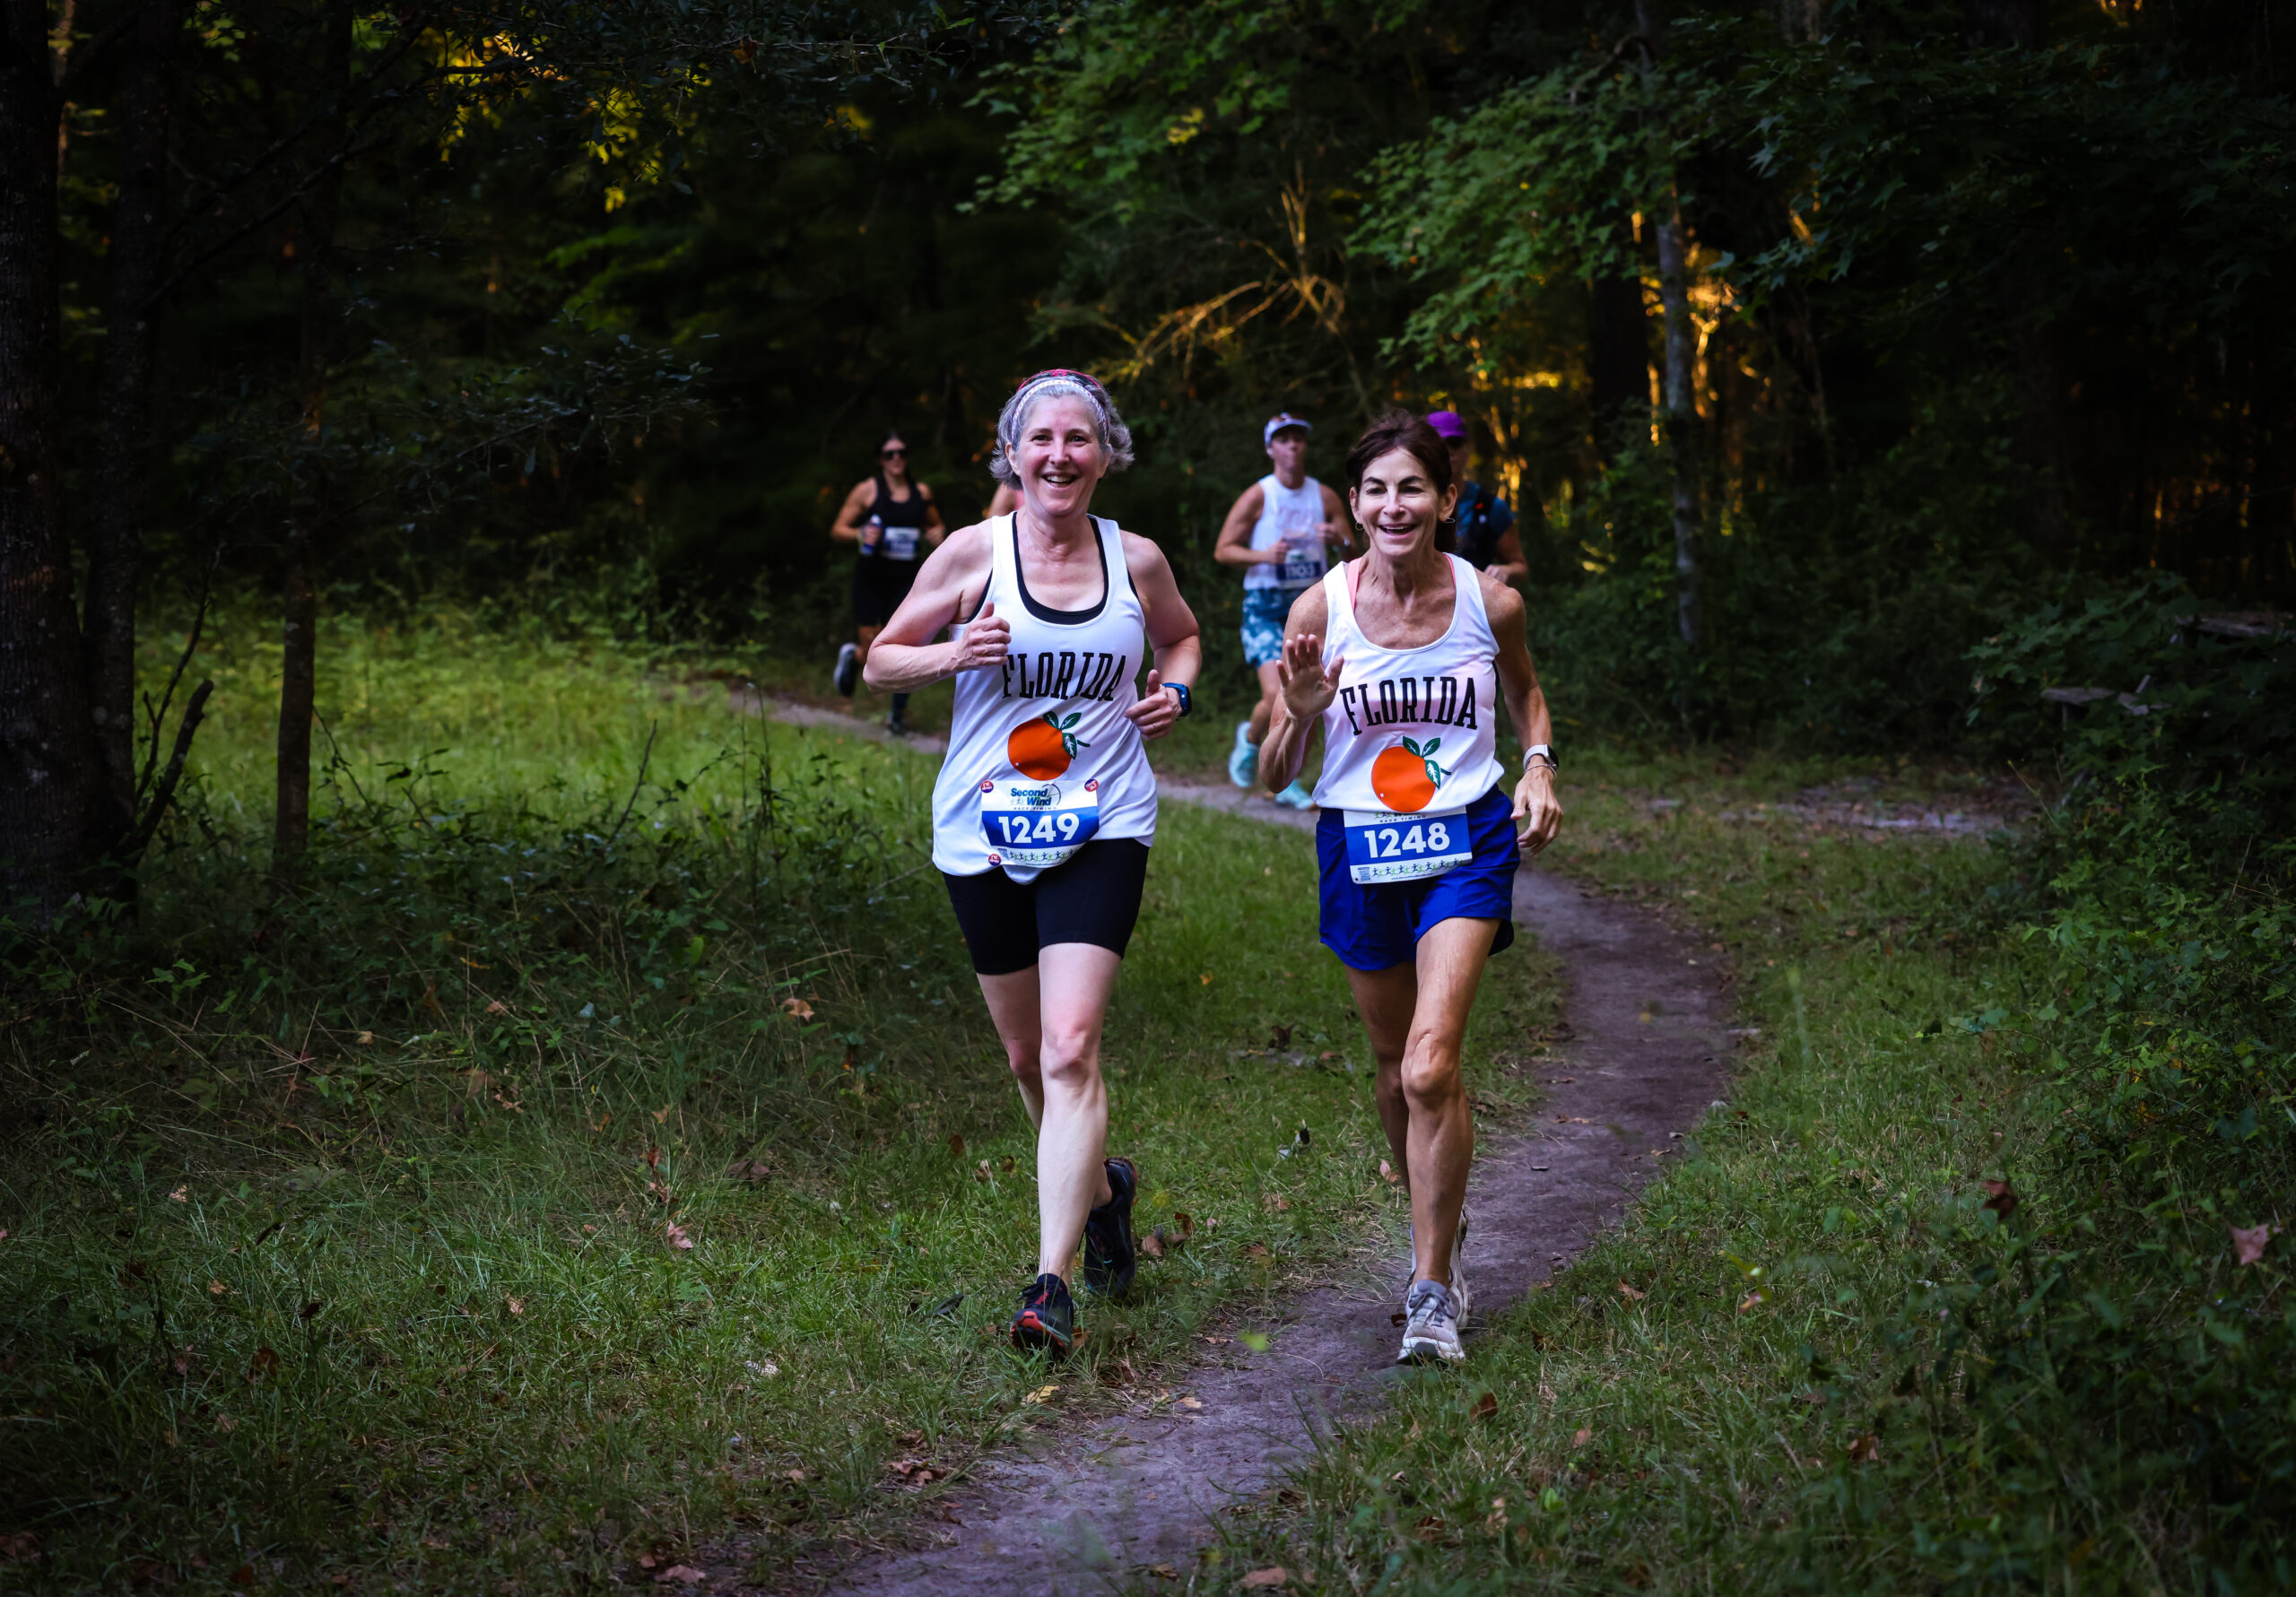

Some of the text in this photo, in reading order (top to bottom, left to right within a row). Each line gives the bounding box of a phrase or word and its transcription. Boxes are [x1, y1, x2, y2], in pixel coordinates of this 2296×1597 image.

[1002, 652, 1126, 701] FLORIDA
[1340, 676, 1479, 735] FLORIDA
[1011, 787, 1048, 797] Second
[1026, 796, 1052, 807] Wind
[997, 812, 1080, 844] 1249
[1363, 821, 1450, 859] 1248
